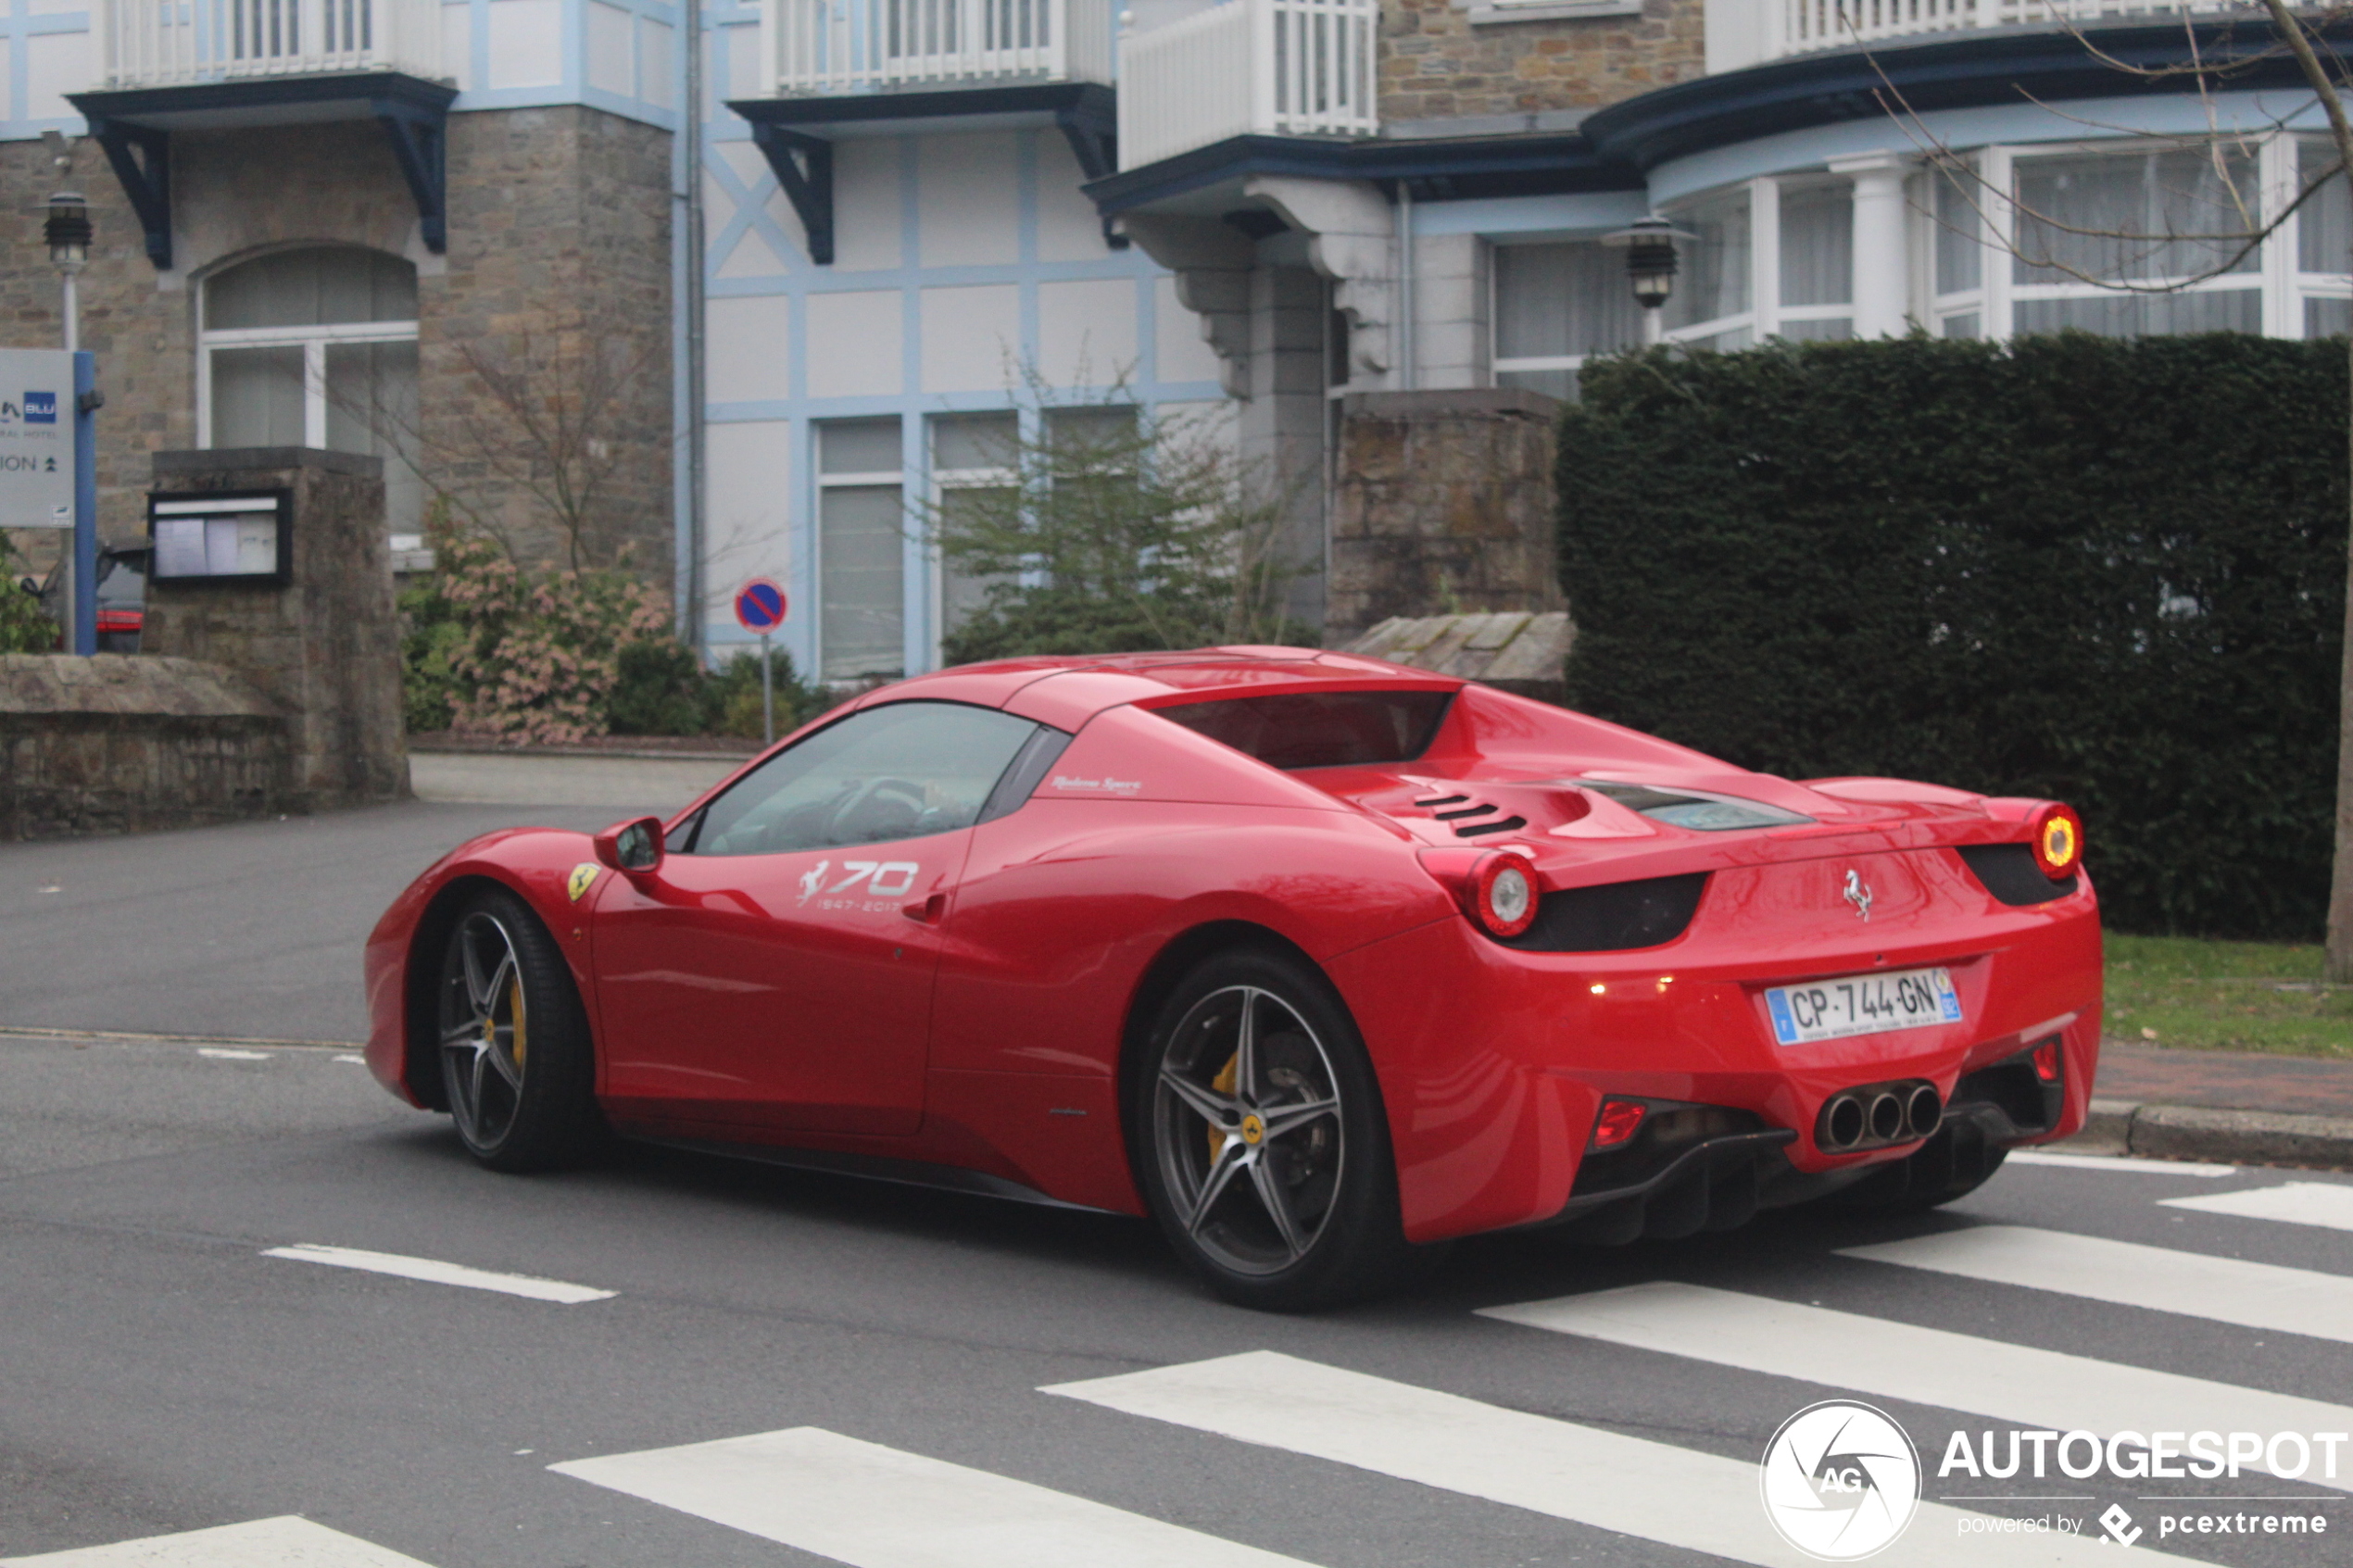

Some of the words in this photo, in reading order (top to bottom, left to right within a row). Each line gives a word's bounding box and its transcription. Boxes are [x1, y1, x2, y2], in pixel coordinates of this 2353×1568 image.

[25, 405, 55, 414] BLU
[24, 430, 57, 440] HOTEL
[825, 860, 919, 896] 70
